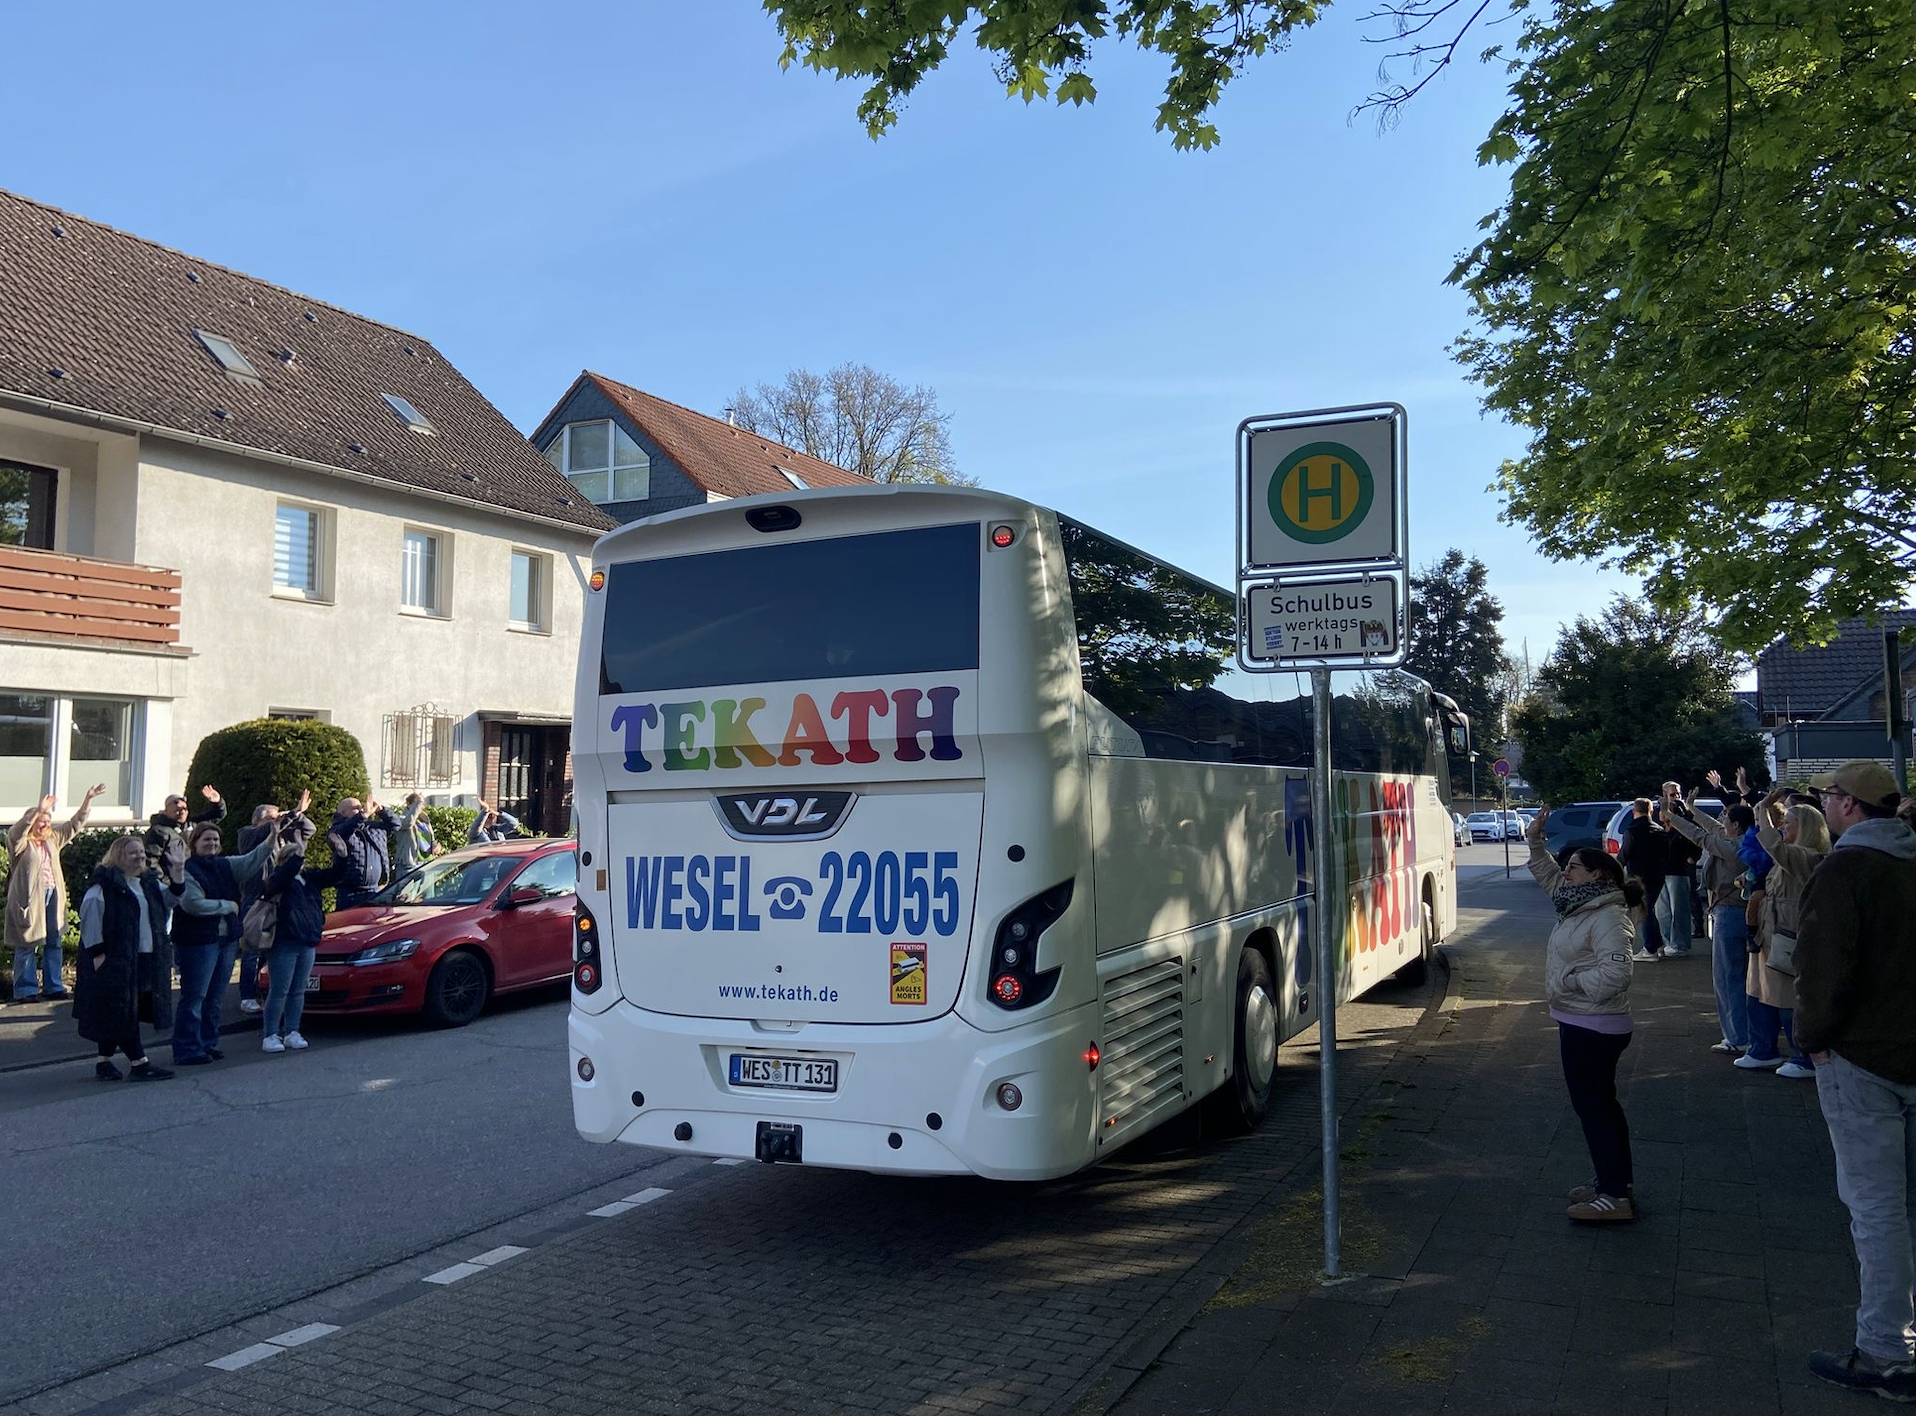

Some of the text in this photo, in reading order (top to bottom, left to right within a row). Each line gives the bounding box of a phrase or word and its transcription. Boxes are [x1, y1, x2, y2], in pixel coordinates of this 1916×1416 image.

[1298, 462, 1341, 523] H
[1270, 592, 1373, 614] Schulbus
[1285, 617, 1358, 632] werktags
[610, 686, 963, 773] TEKATH
[734, 797, 828, 826] VDL
[626, 850, 960, 937] WESEL 22055
[718, 985, 839, 1003] www.tekath.de
[742, 1059, 771, 1080] WES
[783, 1062, 802, 1083] TT
[804, 1064, 833, 1085] 131
